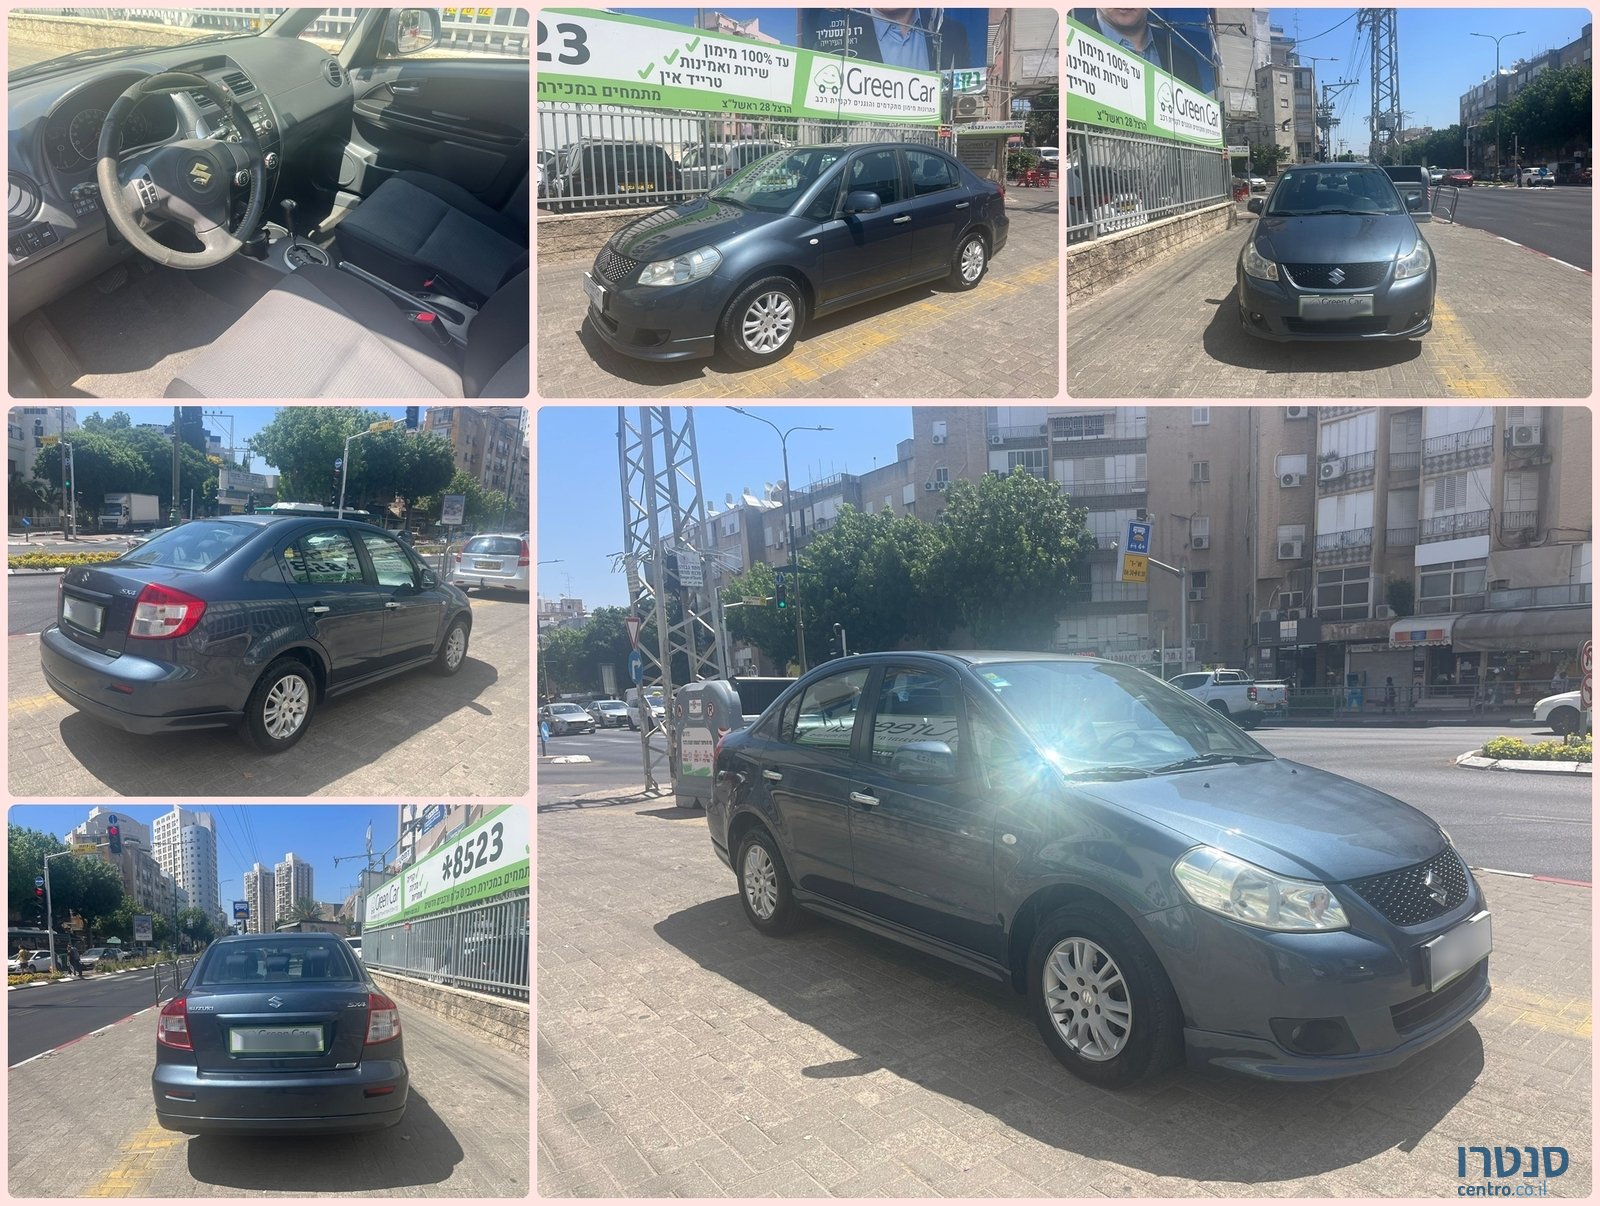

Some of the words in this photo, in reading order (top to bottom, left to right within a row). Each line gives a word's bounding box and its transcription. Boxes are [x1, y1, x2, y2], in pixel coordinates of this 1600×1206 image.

[703, 42, 737, 60] מימון
[741, 49, 772, 66] 100%
[1078, 39, 1104, 63] מימון
[680, 56, 730, 74] ואמינות
[776, 56, 789, 68] עד
[1106, 52, 1130, 74] 100%
[660, 70, 682, 86] אין
[734, 64, 769, 78] שירות
[1103, 70, 1128, 89] שירות
[1130, 66, 1140, 80] עד
[688, 74, 722, 88] טרייד
[846, 67, 904, 100] Green
[908, 78, 936, 103] Car
[1067, 74, 1096, 95] טרייד
[602, 84, 662, 101] מתמחים
[760, 102, 770, 112] 28
[772, 104, 792, 114] הרצל
[1176, 88, 1205, 123] Green
[1206, 104, 1218, 127] Car
[1125, 116, 1132, 127] 28
[121, 588, 137, 596] SX4
[478, 876, 502, 893] במכירת
[376, 894, 388, 911] Green
[390, 884, 399, 904] Car
